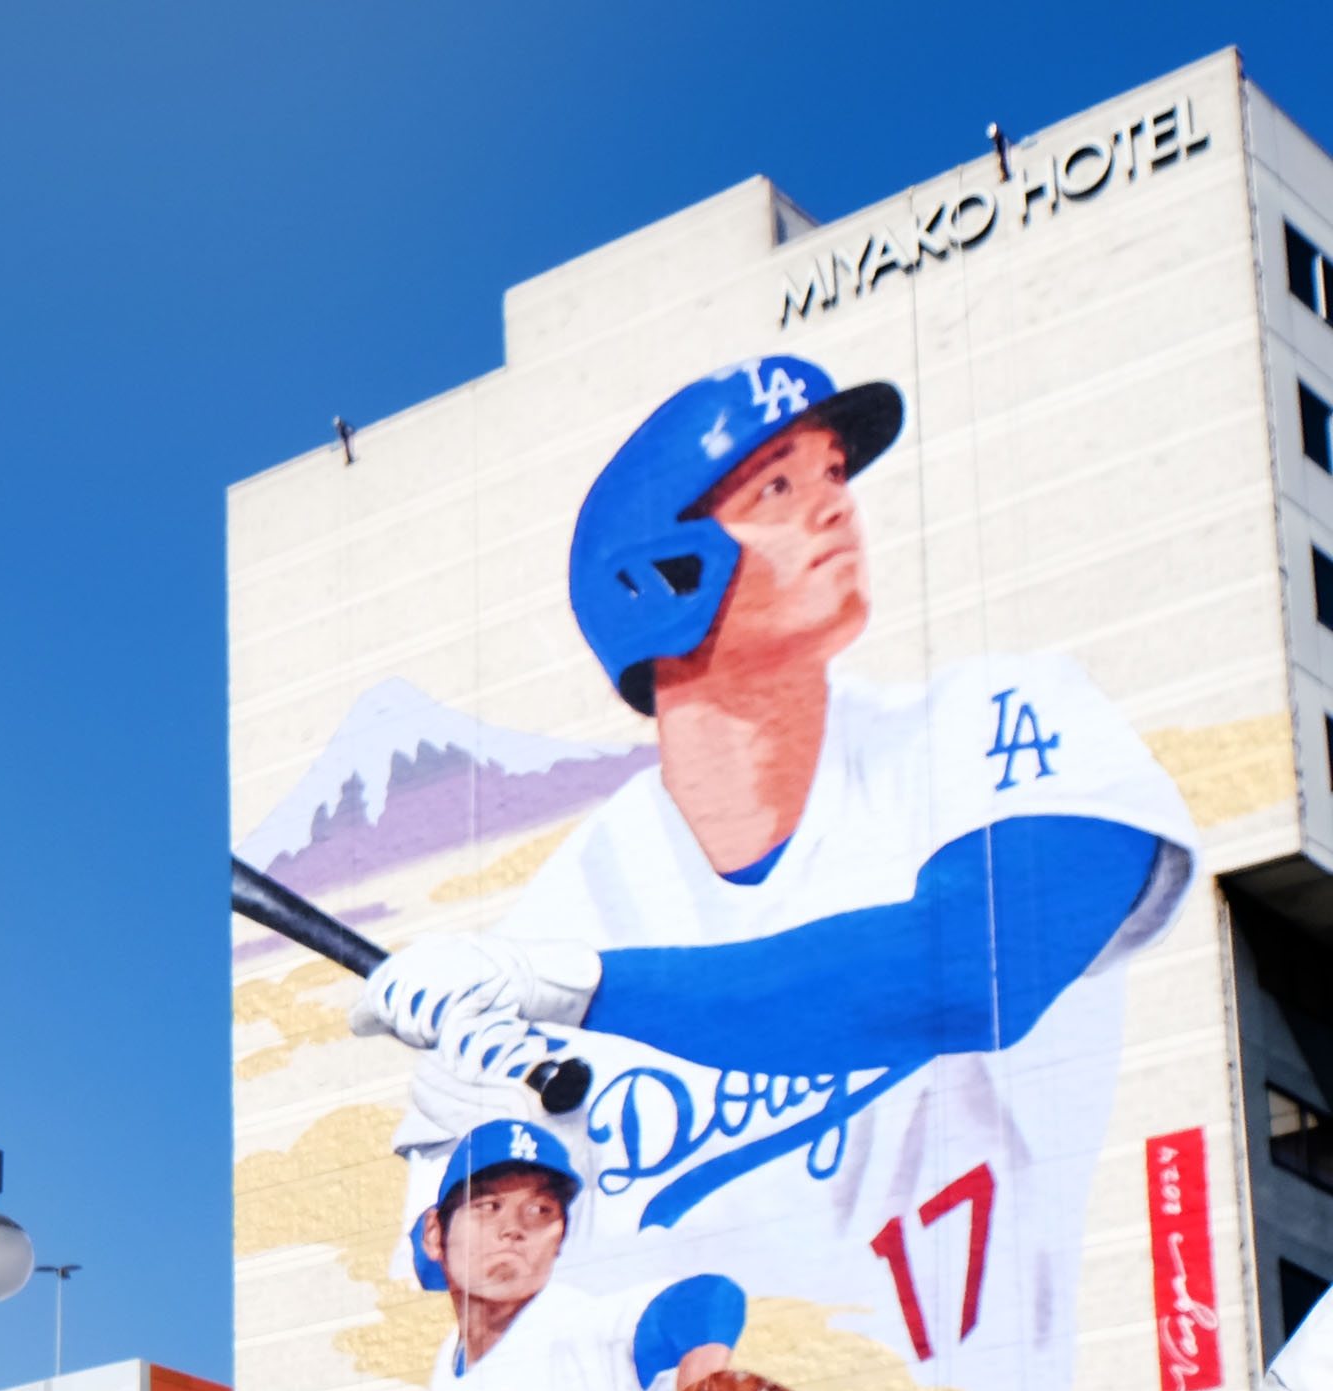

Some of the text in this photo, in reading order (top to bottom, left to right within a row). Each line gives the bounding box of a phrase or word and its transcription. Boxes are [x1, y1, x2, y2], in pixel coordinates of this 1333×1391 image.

[779, 96, 1212, 329] MIYAKO HOTEL
[742, 358, 810, 425] LA
[985, 686, 1061, 792] LA
[509, 1123, 539, 1162] LA
[869, 1160, 996, 1363] 17
